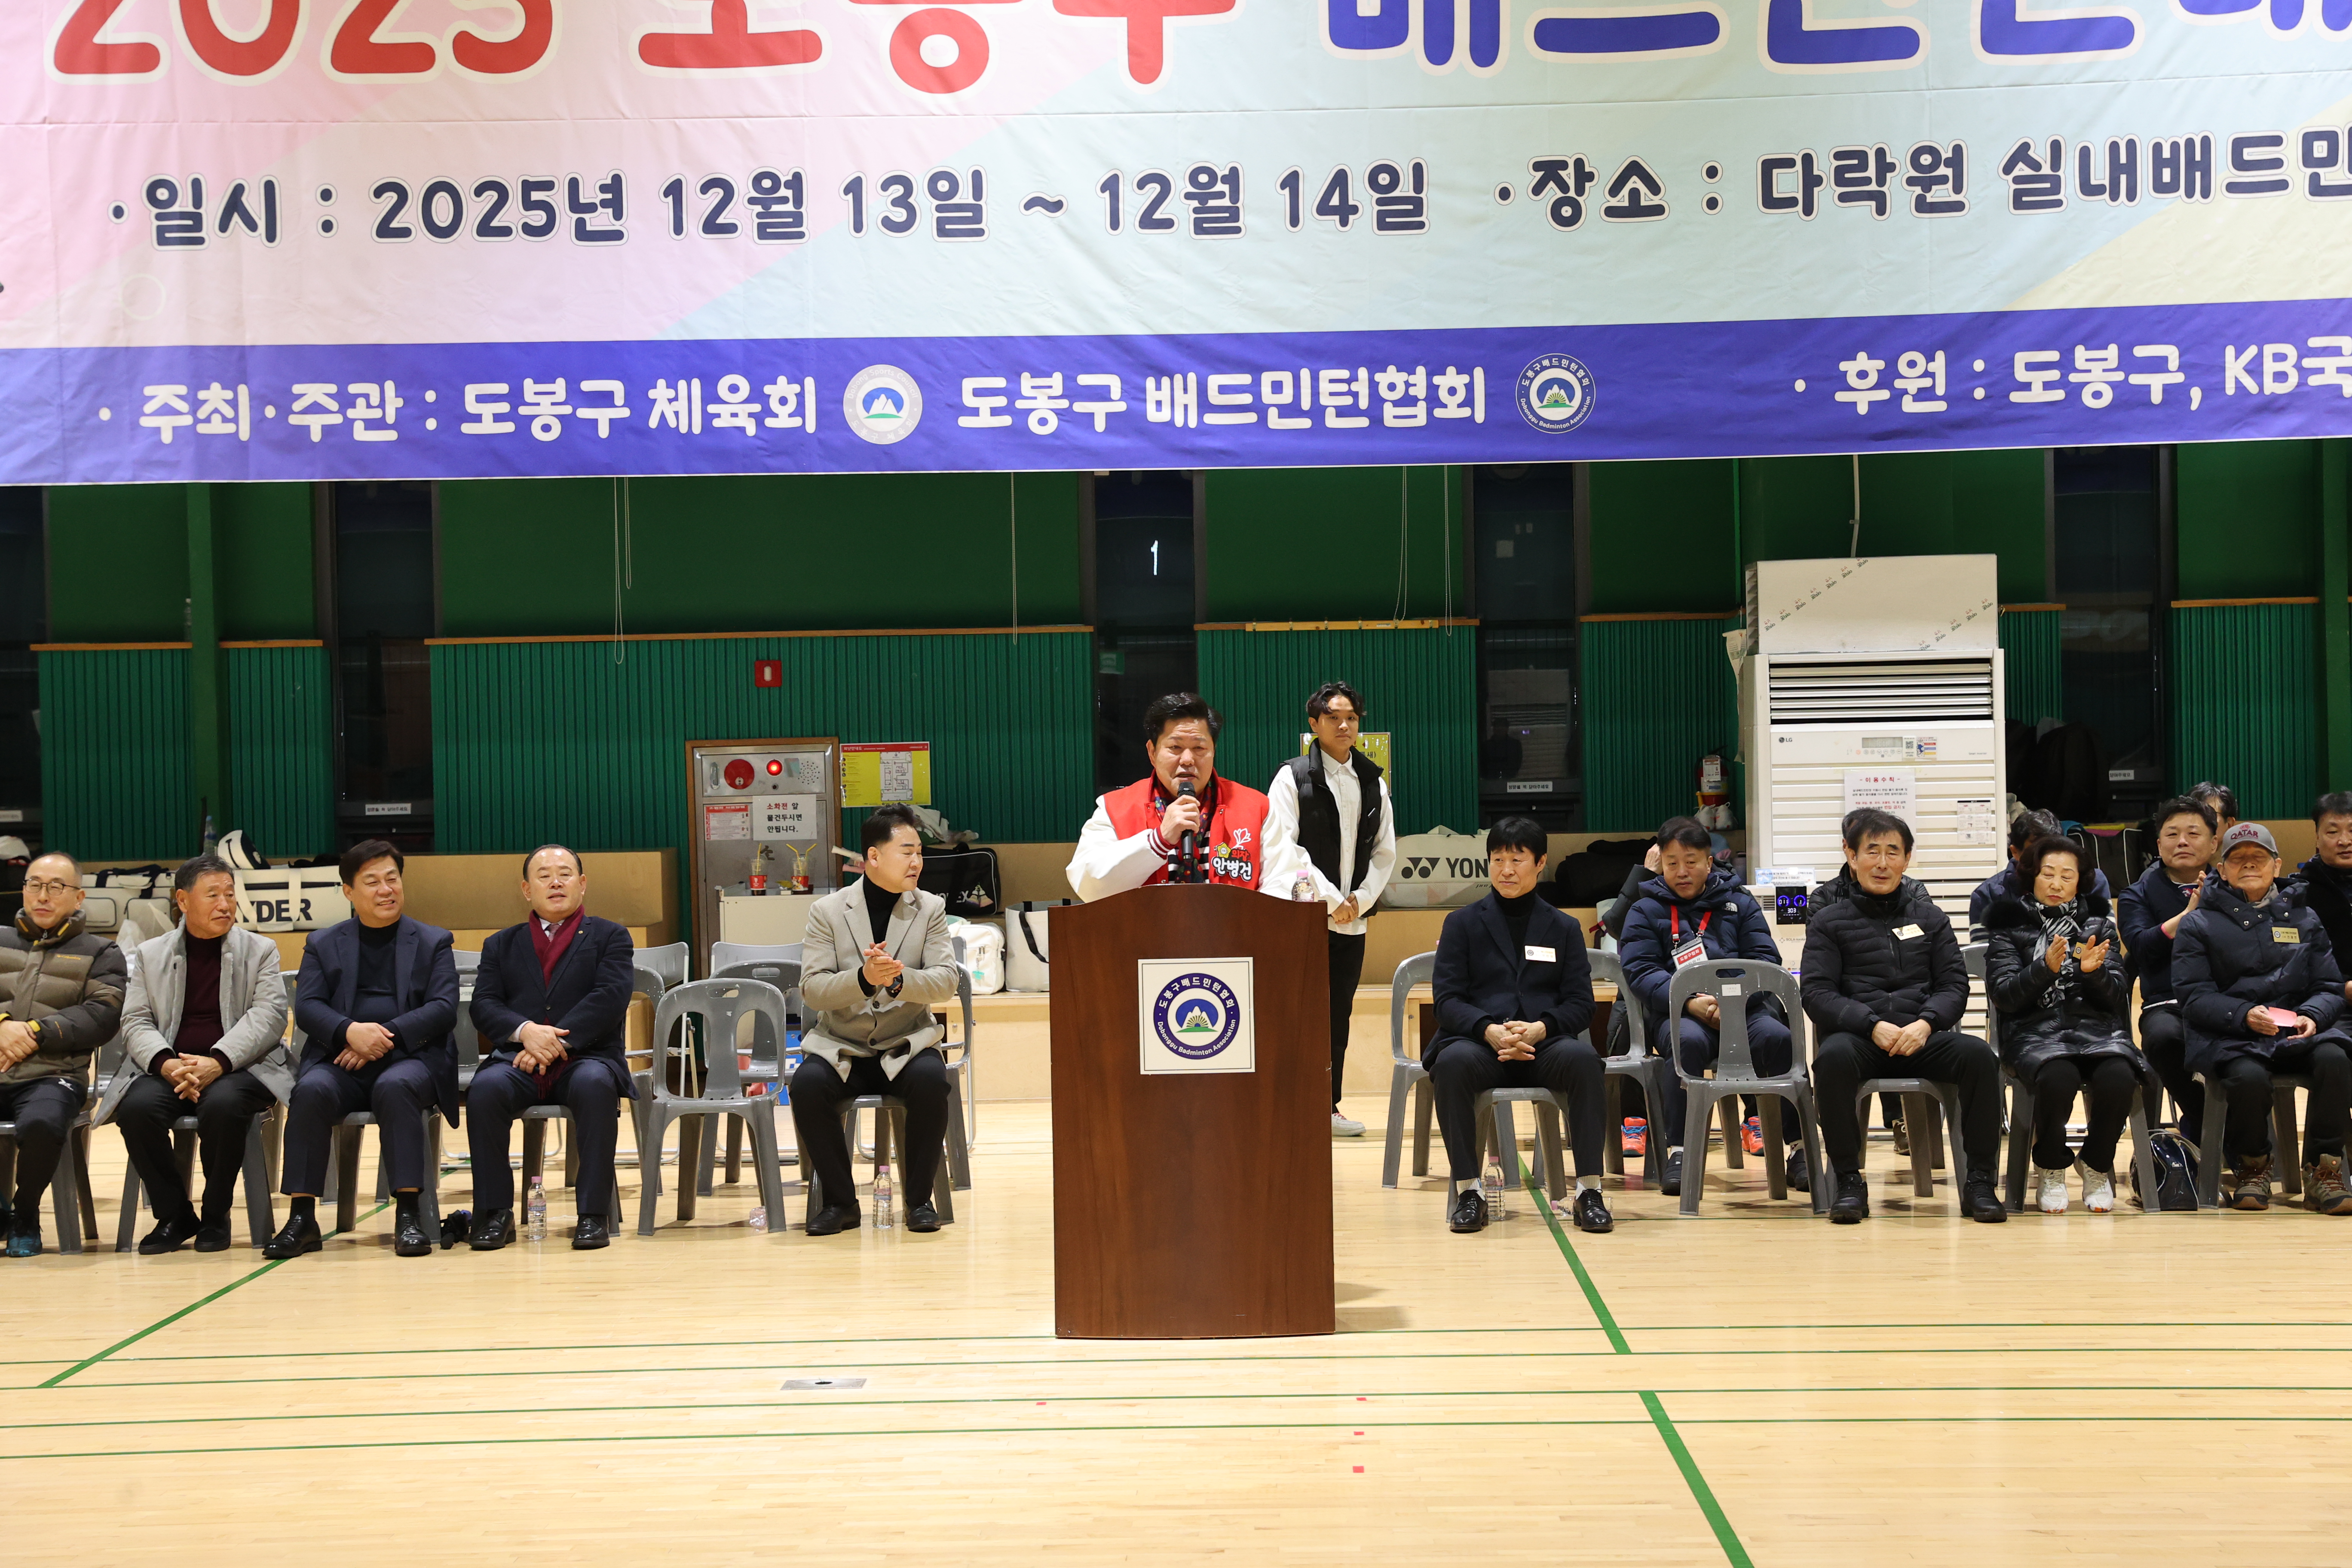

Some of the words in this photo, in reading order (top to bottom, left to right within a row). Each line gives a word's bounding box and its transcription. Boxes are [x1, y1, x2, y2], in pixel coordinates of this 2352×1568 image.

[374, 174, 624, 242] 2025년
[663, 172, 805, 239] 12월
[844, 170, 985, 237] 13일
[1099, 166, 1241, 235] 12월
[1280, 162, 1425, 231] 14일
[1761, 144, 1965, 216] 다락원
[461, 378, 630, 441] 도봉구
[648, 374, 816, 436] 체육회
[958, 372, 1127, 435] 도봉구
[1146, 365, 1485, 429] 배드민턴협회
[1835, 351, 1947, 414] 후원
[2009, 344, 2202, 410] 도봉구,
[847, 373, 868, 399] Dobong
[897, 373, 918, 398] Council
[1521, 398, 1538, 423] Dobonggu
[1539, 420, 1570, 429] Badminton
[1570, 396, 1591, 425] Association
[2231, 830, 2258, 839] QATAR
[1213, 858, 1251, 880] 안병건
[1231, 849, 1249, 861] 의장
[1680, 949, 1700, 962] 도봉구협회
[1159, 977, 1234, 1009] 도봉구배드민턴협회
[1158, 1021, 1177, 1050] Dobonggu
[1178, 1046, 1213, 1056] Badminton
[1212, 1019, 1236, 1051] Association
